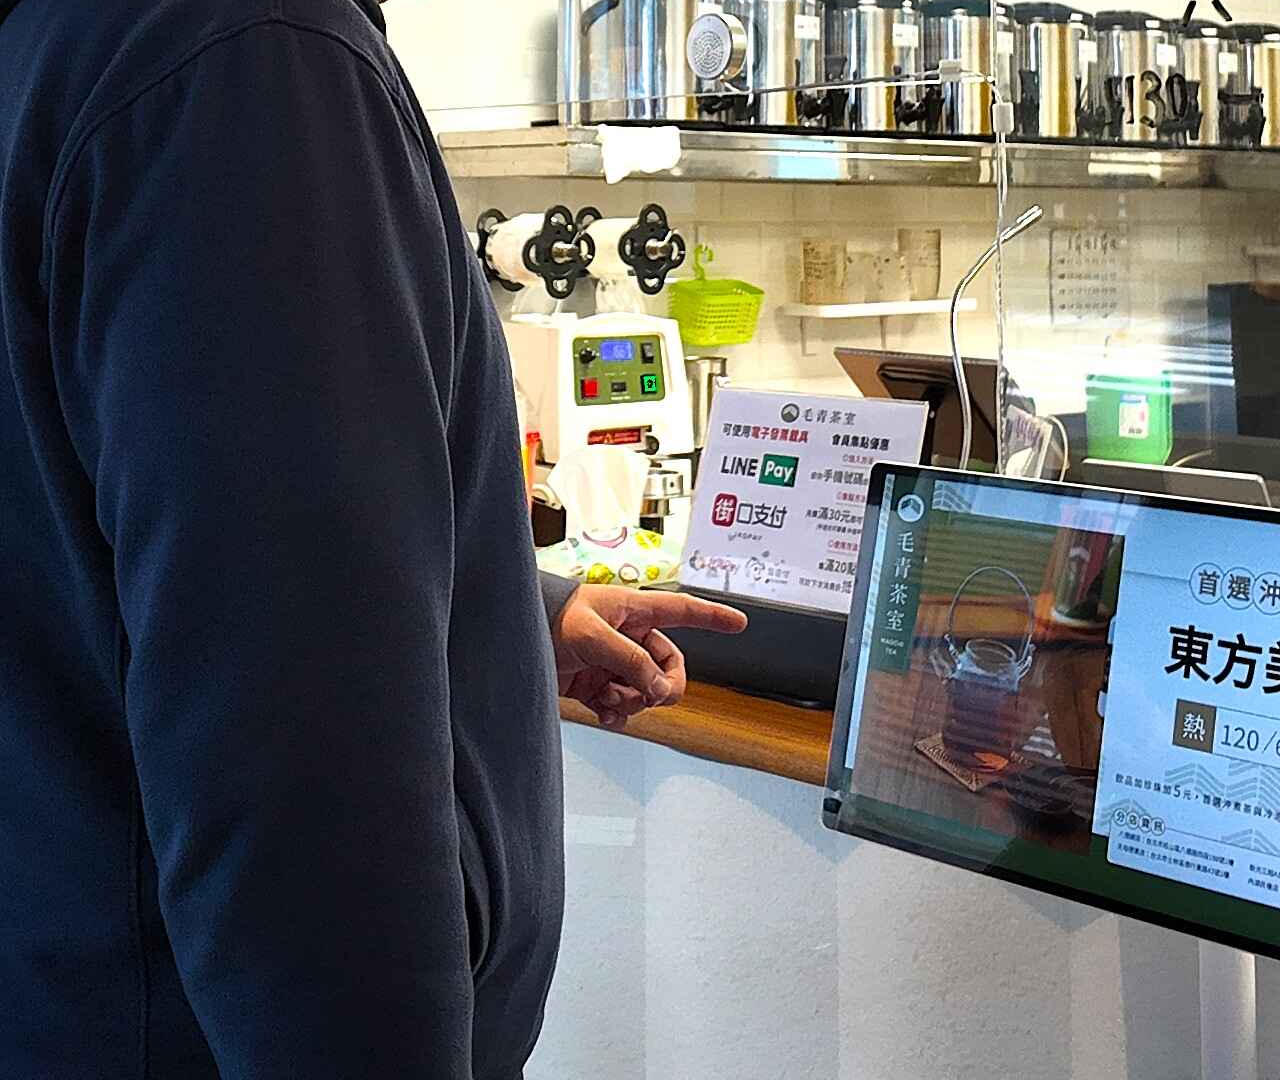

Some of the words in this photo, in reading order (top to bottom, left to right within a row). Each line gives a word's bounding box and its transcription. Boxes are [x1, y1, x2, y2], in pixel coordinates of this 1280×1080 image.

[721, 456, 758, 476] LINE
[764, 461, 793, 483] Pay
[714, 497, 787, 528] 街口支付
[885, 531, 914, 631] 毛青茶室
[1182, 713, 1206, 742] 熱
